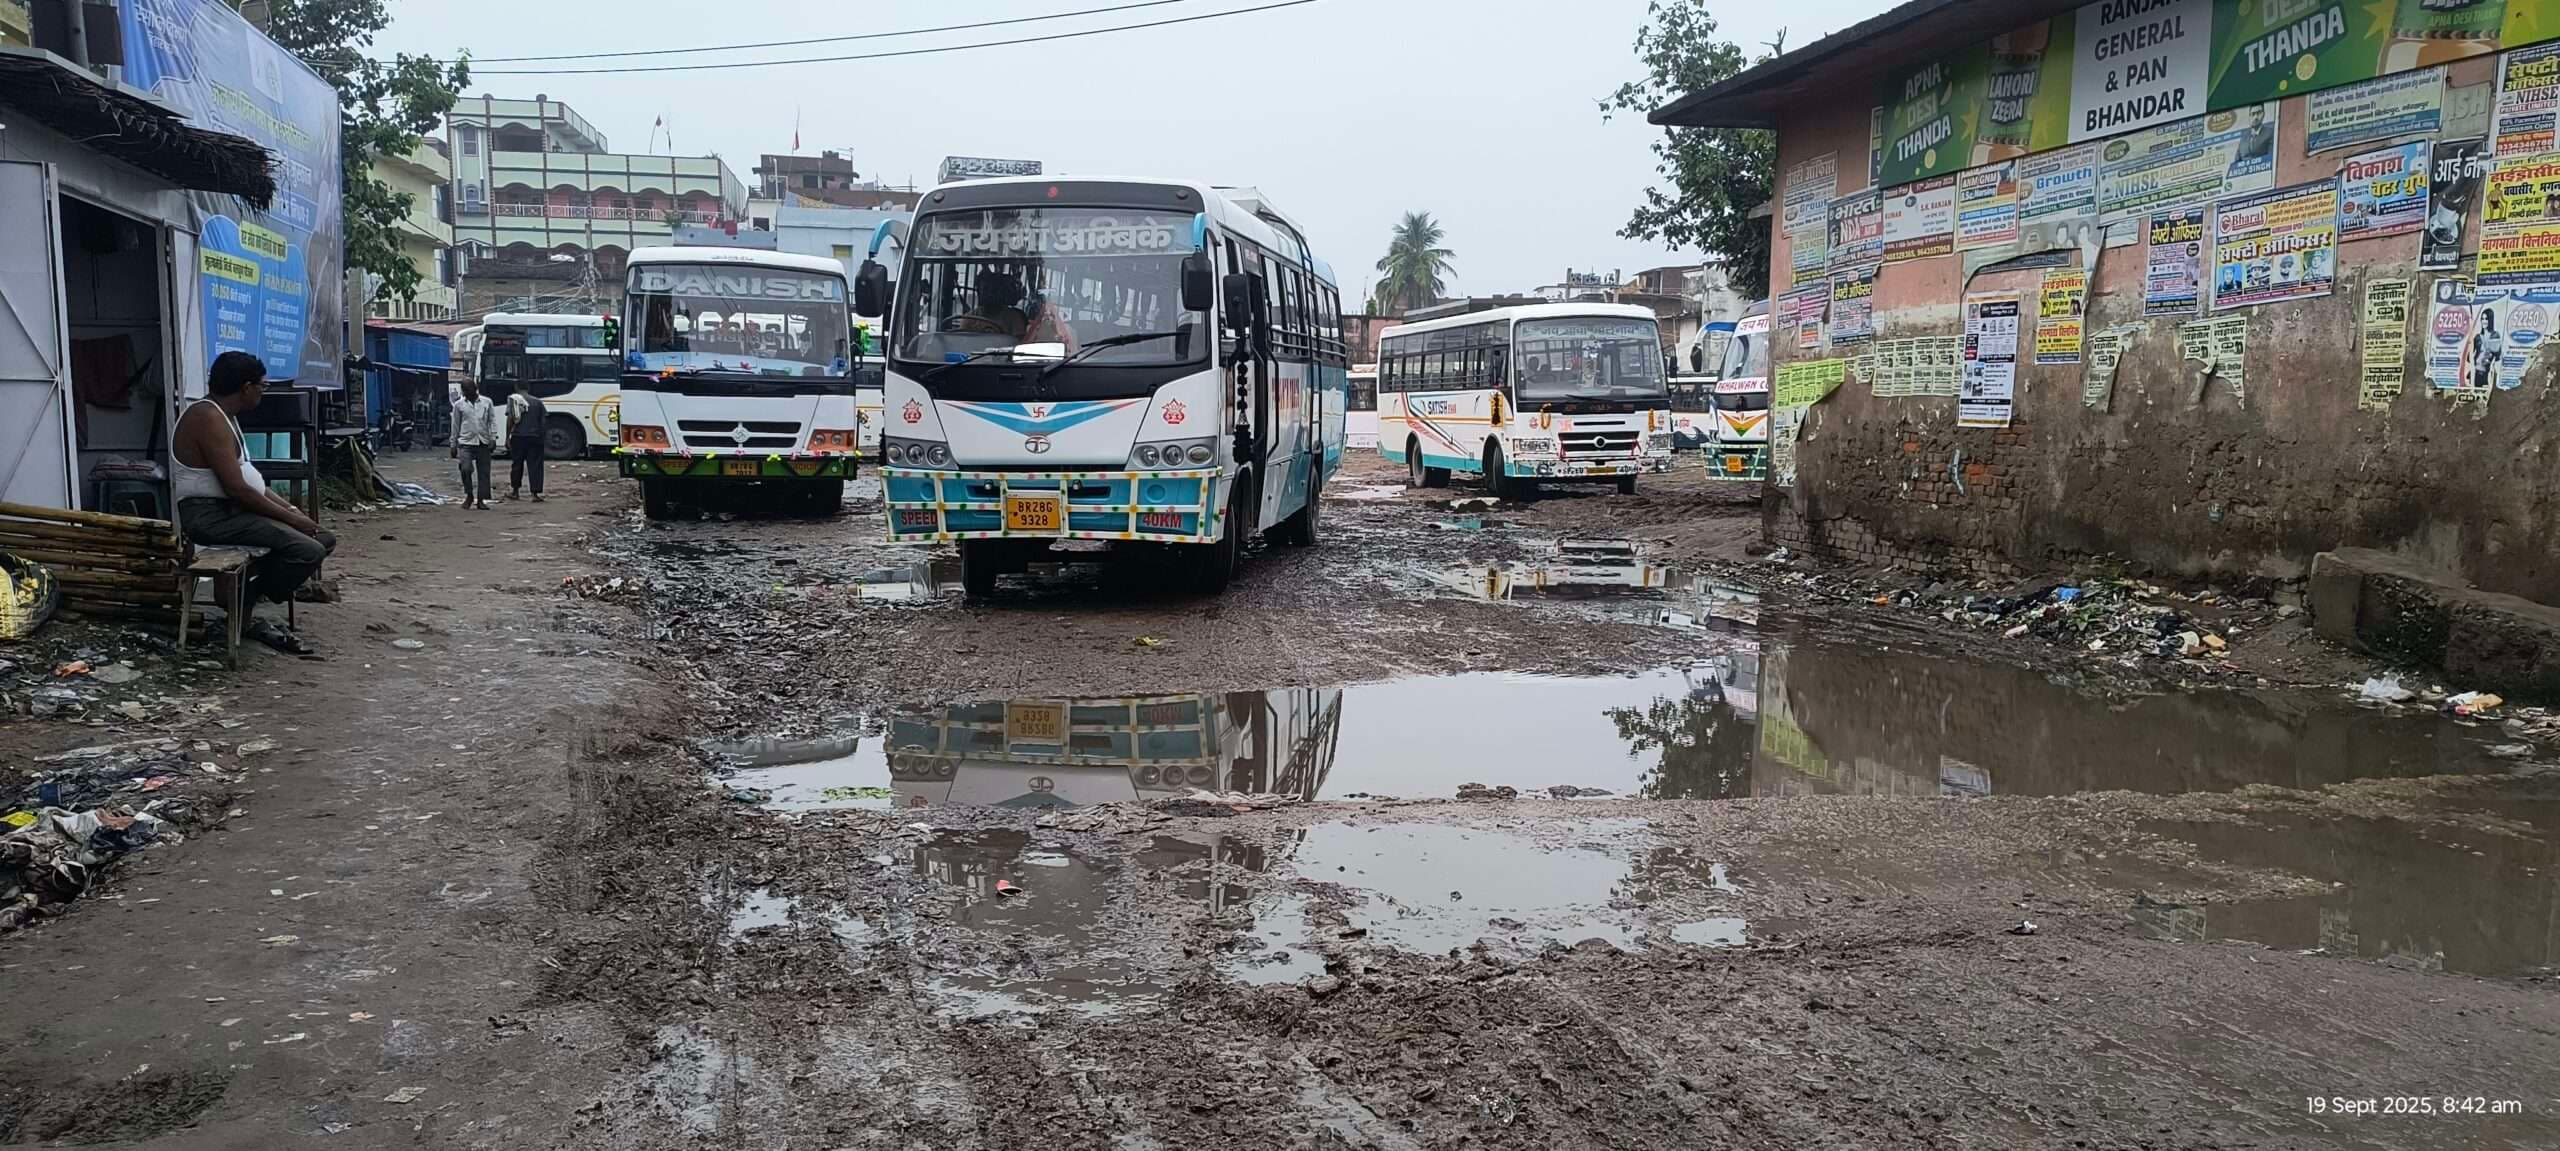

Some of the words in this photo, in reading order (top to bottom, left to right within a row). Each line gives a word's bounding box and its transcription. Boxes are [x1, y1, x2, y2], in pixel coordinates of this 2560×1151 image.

[2100, 0, 2180, 26] RANJA
[2095, 15, 2185, 62] GENERAL
[2244, 6, 2345, 73] THANDA
[1905, 62, 1942, 101] APNA
[1988, 71, 2035, 98] LAHORI
[2105, 70, 2119, 93] &
[2126, 55, 2168, 88] PAN
[2516, 86, 2558, 105] NIHSE
[1907, 92, 1936, 129] DESI
[1992, 98, 2024, 121] ZEERA
[2085, 87, 2185, 132] BHANDAR
[1896, 114, 1952, 162] THANDA
[2036, 167, 2092, 189] Growth
[2248, 161, 2271, 173] SINGH
[2112, 173, 2160, 199] NIHSE
[1840, 215, 1860, 243] NDA
[2231, 211, 2264, 225] Bharat
[639, 271, 835, 298] DANISH
[1428, 400, 1448, 415] SATISH
[901, 512, 938, 526] SPEED
[1142, 513, 1182, 529] 40KM
[1018, 501, 1053, 514] BR28G
[1020, 514, 1049, 527] 9328
